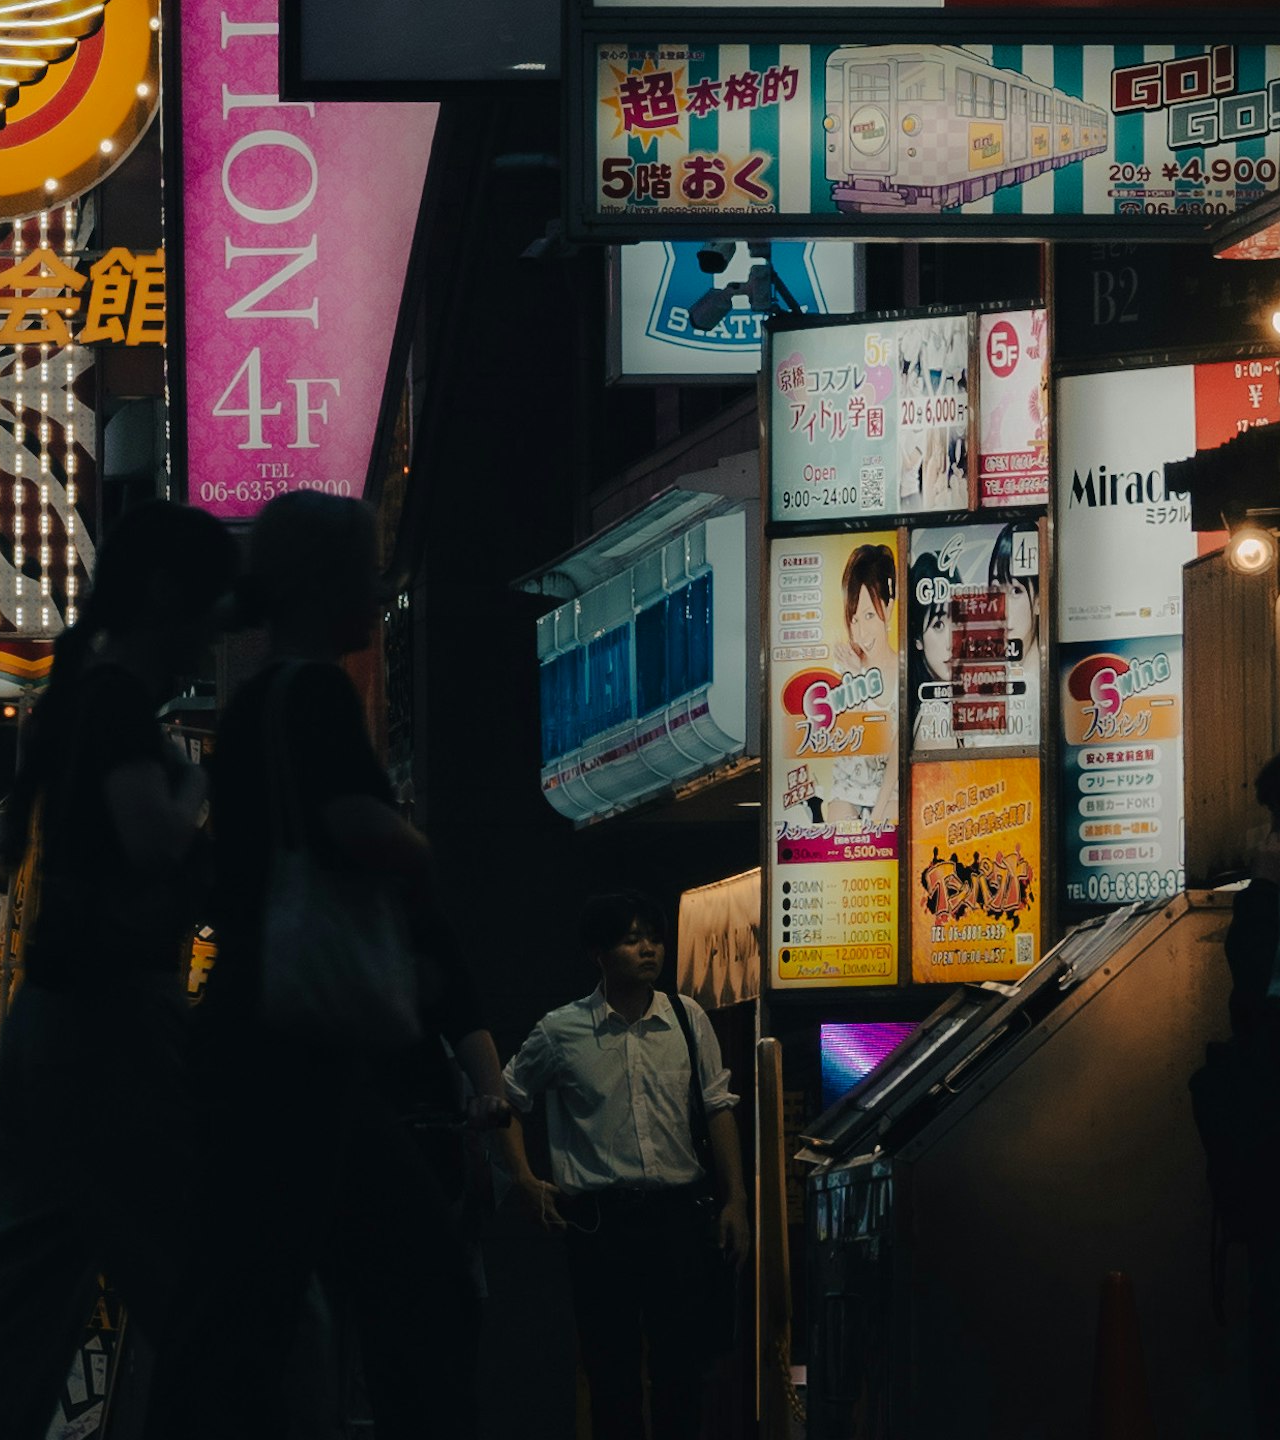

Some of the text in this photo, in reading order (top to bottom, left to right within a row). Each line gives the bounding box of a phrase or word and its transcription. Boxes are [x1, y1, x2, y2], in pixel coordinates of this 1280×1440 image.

[1111, 45, 1237, 115] GO!
[620, 65, 799, 132] 超本格的
[602, 155, 769, 201] 5階 おく
[1109, 158, 1277, 185] 20分 ¥4,900
[1093, 266, 1139, 326] B2
[990, 331, 1019, 369] 5F
[212, 346, 341, 451] 4F
[790, 396, 884, 443] アイドル学園
[256, 462, 295, 480] TEL
[803, 464, 837, 485] Open
[1145, 505, 1190, 525] ミラクル
[1014, 537, 1038, 570] 4F
[1082, 704, 1152, 741] スウィング
[795, 721, 865, 756] スウィング
[1086, 773, 1154, 788] フリードリンク
[843, 845, 894, 860] 5,500YEN
[791, 880, 824, 894] 30MIN
[1067, 883, 1087, 900] TEL
[791, 896, 824, 910] 40MIN
[791, 913, 824, 927] 50MIN
[791, 949, 823, 963] 60MIN
